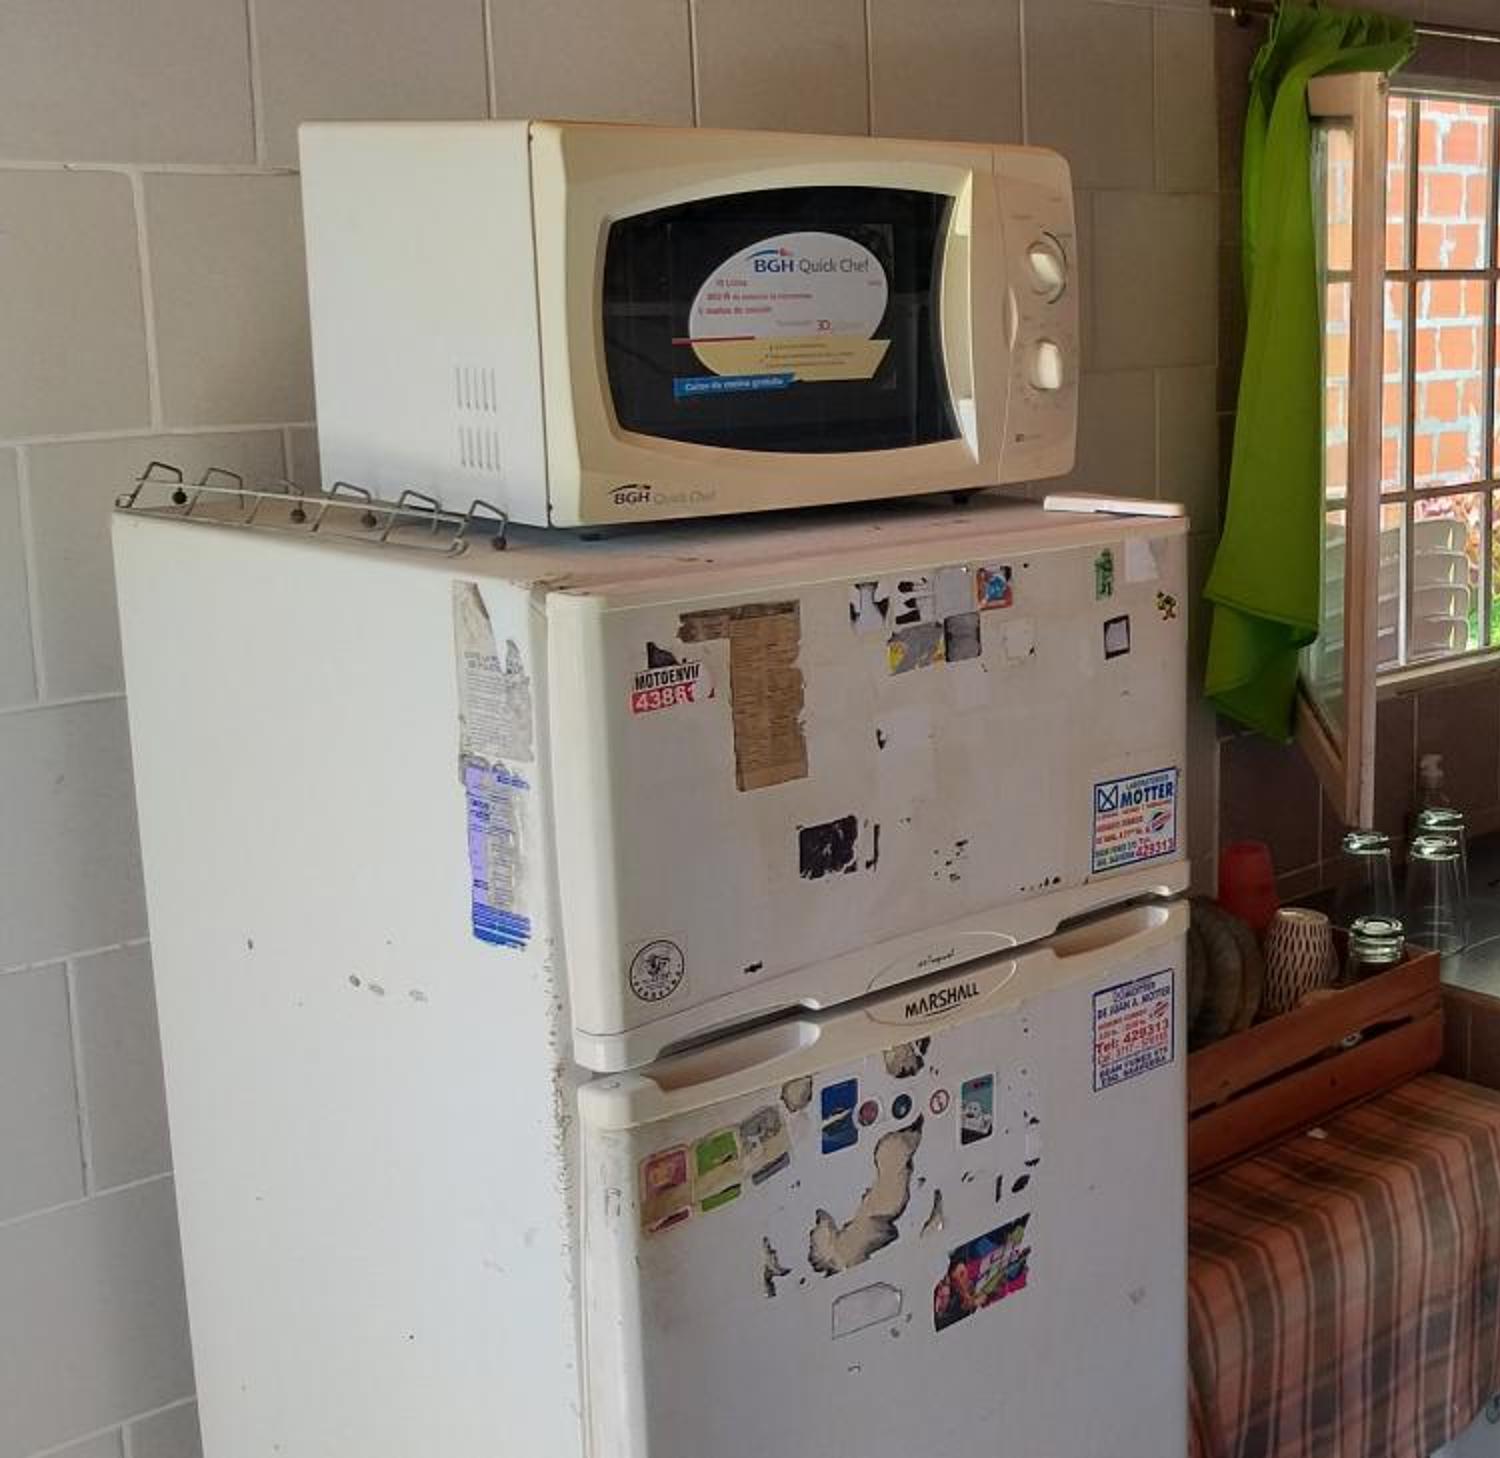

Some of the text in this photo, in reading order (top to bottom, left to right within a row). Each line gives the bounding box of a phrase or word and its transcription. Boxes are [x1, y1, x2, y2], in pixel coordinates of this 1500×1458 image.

[754, 258, 870, 275] BGH Quick Chef
[614, 491, 650, 505] BGH
[1120, 782, 1173, 808] MOTTER
[905, 982, 979, 1019] MARSHALL
